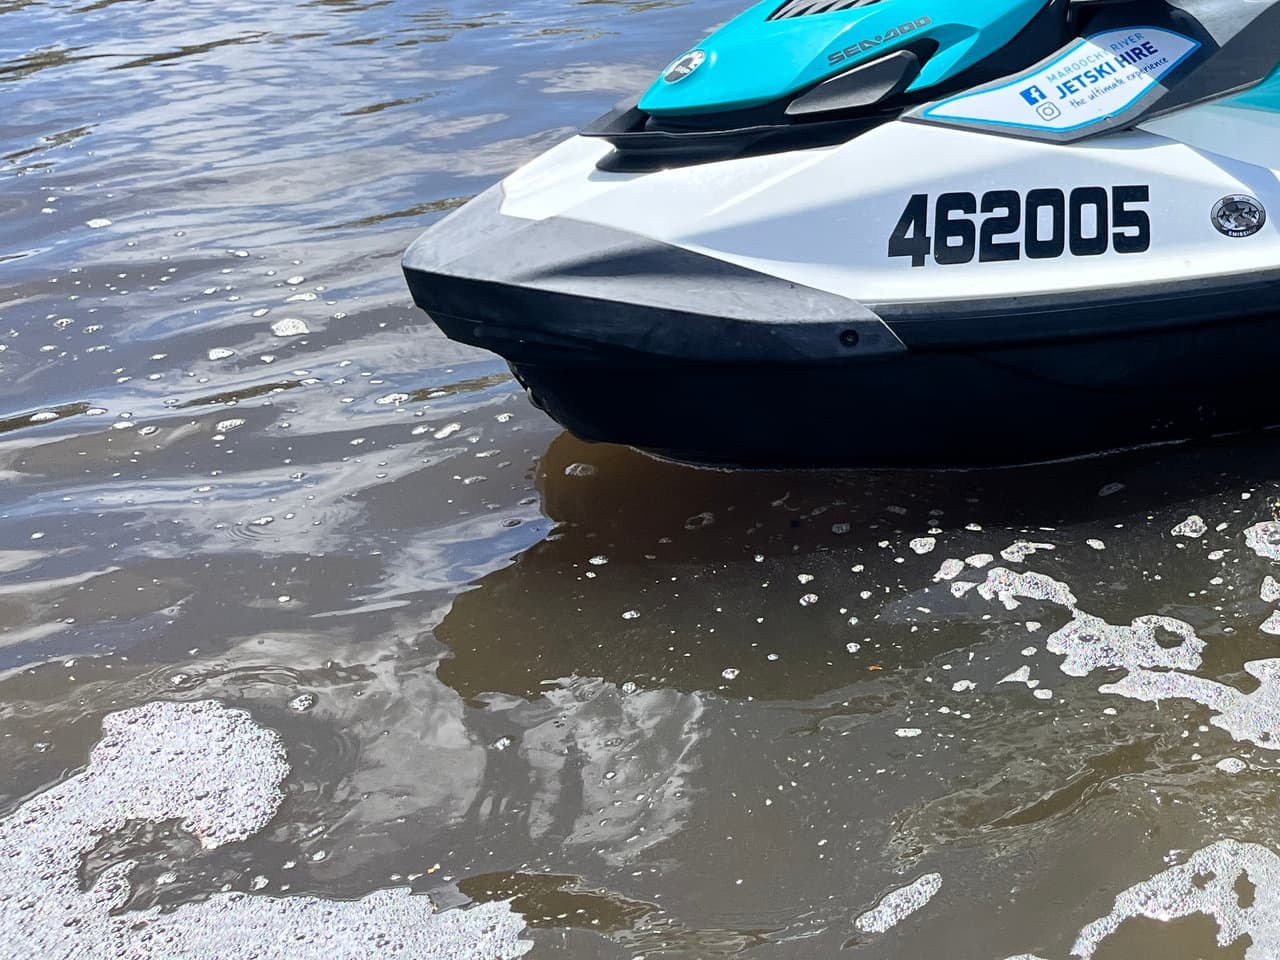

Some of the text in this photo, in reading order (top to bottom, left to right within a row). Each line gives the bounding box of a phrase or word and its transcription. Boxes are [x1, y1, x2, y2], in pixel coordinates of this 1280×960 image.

[1110, 32, 1145, 52] RIVER
[1055, 41, 1158, 100] JETSKI HIRE
[1070, 57, 1169, 109] the ultimate experience
[887, 184, 1151, 268] 462005
